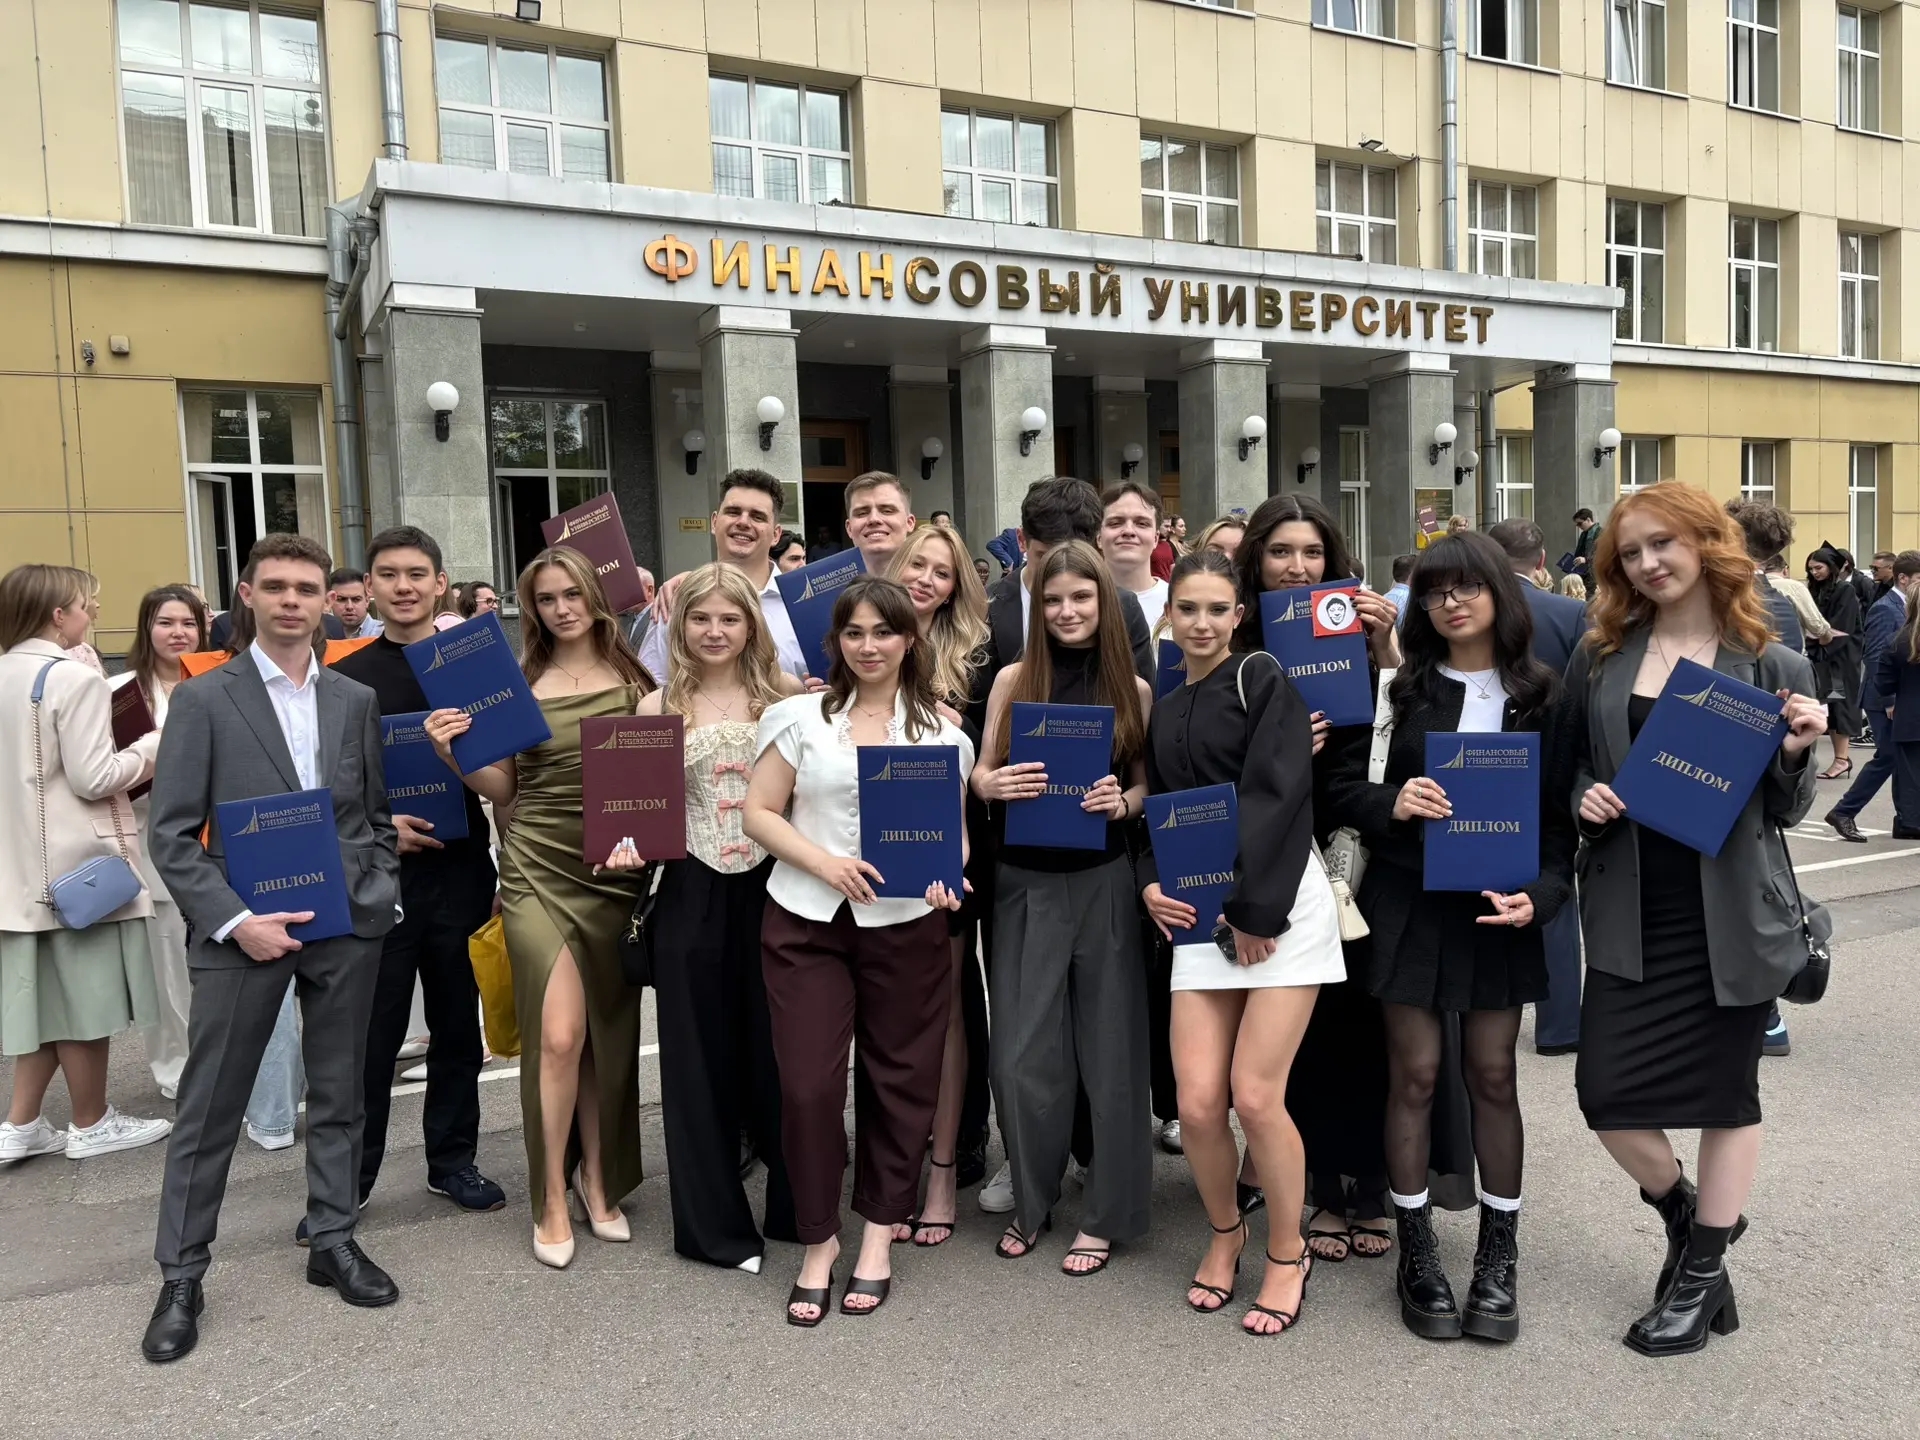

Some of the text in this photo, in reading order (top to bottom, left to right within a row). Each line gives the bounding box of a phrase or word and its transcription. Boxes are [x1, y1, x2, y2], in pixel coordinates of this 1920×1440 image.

[643, 234, 1494, 343] ФИНАНСОВЫЙ УНИВЕРСИТЕТ
[441, 626, 491, 653] ФИНАНСОВЫЙ
[444, 633, 493, 660] УНИВЕРСИТЕТ
[1287, 659, 1351, 678] ДИПЛОМ
[460, 687, 514, 715] ИПЛОМ
[1711, 691, 1780, 724] ФИНАНСОВЫЙ
[1708, 699, 1775, 731] УНИВЕРСИТЕТ
[394, 725, 425, 735] ФИНАНС
[1046, 719, 1103, 728] ФИНАНСОВЫЙ
[1047, 726, 1103, 736] УНИВЕРСИТЕТ
[395, 732, 429, 741] УНИВЕРС
[618, 728, 674, 738] ФИНАНСОВЫЙ
[618, 737, 674, 745] УНИВЕРСИТЕТ
[1465, 747, 1528, 756] ФИНАНСОВЫЙ
[891, 759, 947, 769] ФИНАНСОВЫЙ
[1465, 757, 1528, 765] УНИВЕРСИТЕТ
[892, 769, 948, 777] УНИВЕРСИТЕТ
[1650, 750, 1732, 793] ДИПЛОМ
[386, 782, 447, 800] ДИПЛОМ
[258, 802, 321, 820] ФИНАНСОВЫЙ
[602, 799, 668, 814] ДИПЛОМ
[1175, 799, 1227, 815] ФИНАНСОВЫЙ
[261, 811, 322, 828] УНИВЕРСИТЕТ
[1177, 808, 1228, 823] УНИВЕРСИТЕТ
[1447, 820, 1520, 834] ДИПЛОМ
[879, 830, 943, 844] ДИПЛОМ
[253, 871, 326, 896] ДИПЛОМ
[1176, 870, 1235, 891] ДИПЛОМ
